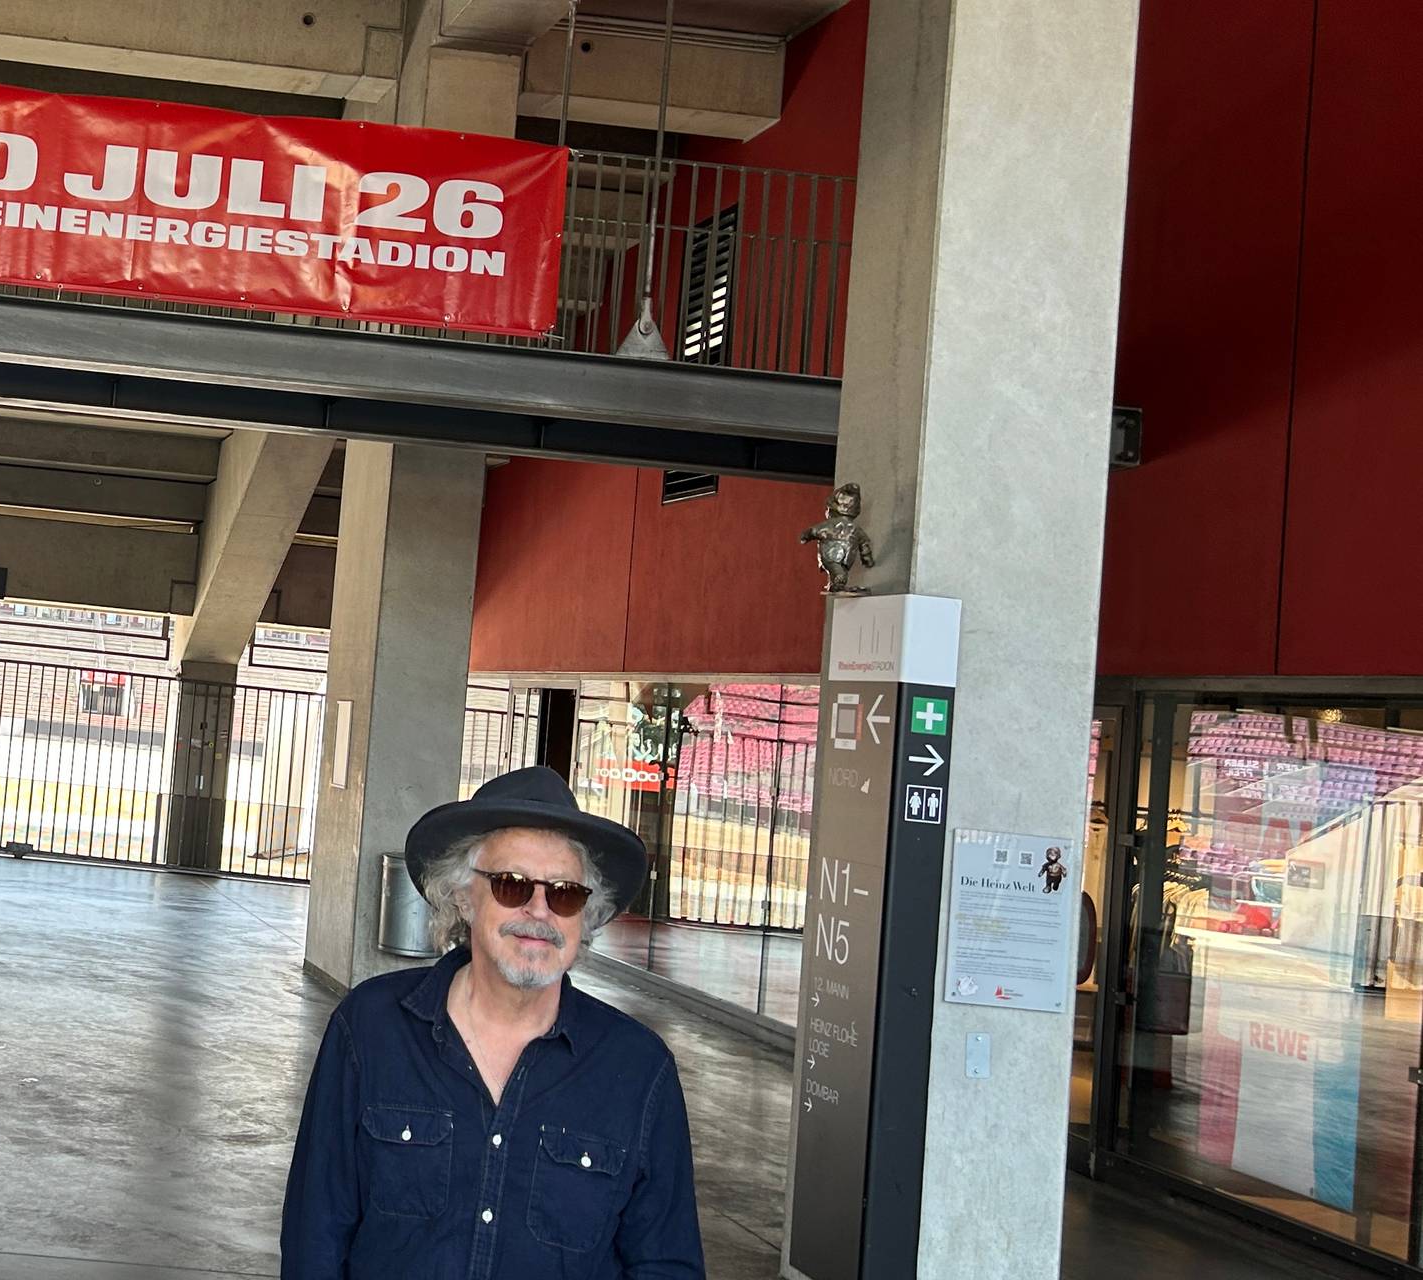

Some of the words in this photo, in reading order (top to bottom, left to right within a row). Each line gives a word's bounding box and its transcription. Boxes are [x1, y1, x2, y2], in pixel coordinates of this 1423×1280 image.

[64, 145, 325, 222] JULI
[356, 171, 504, 239] 26
[960, 875, 979, 887] Die
[981, 877, 1011, 890] Heinz
[1013, 880, 1036, 893] Welt
[815, 912, 850, 965] N5
[825, 979, 850, 1000] MANN
[809, 1017, 832, 1037] HEINZ
[808, 1037, 831, 1058] LOGE
[1248, 1020, 1310, 1062] REWE
[806, 1078, 839, 1105] DOMBAR
